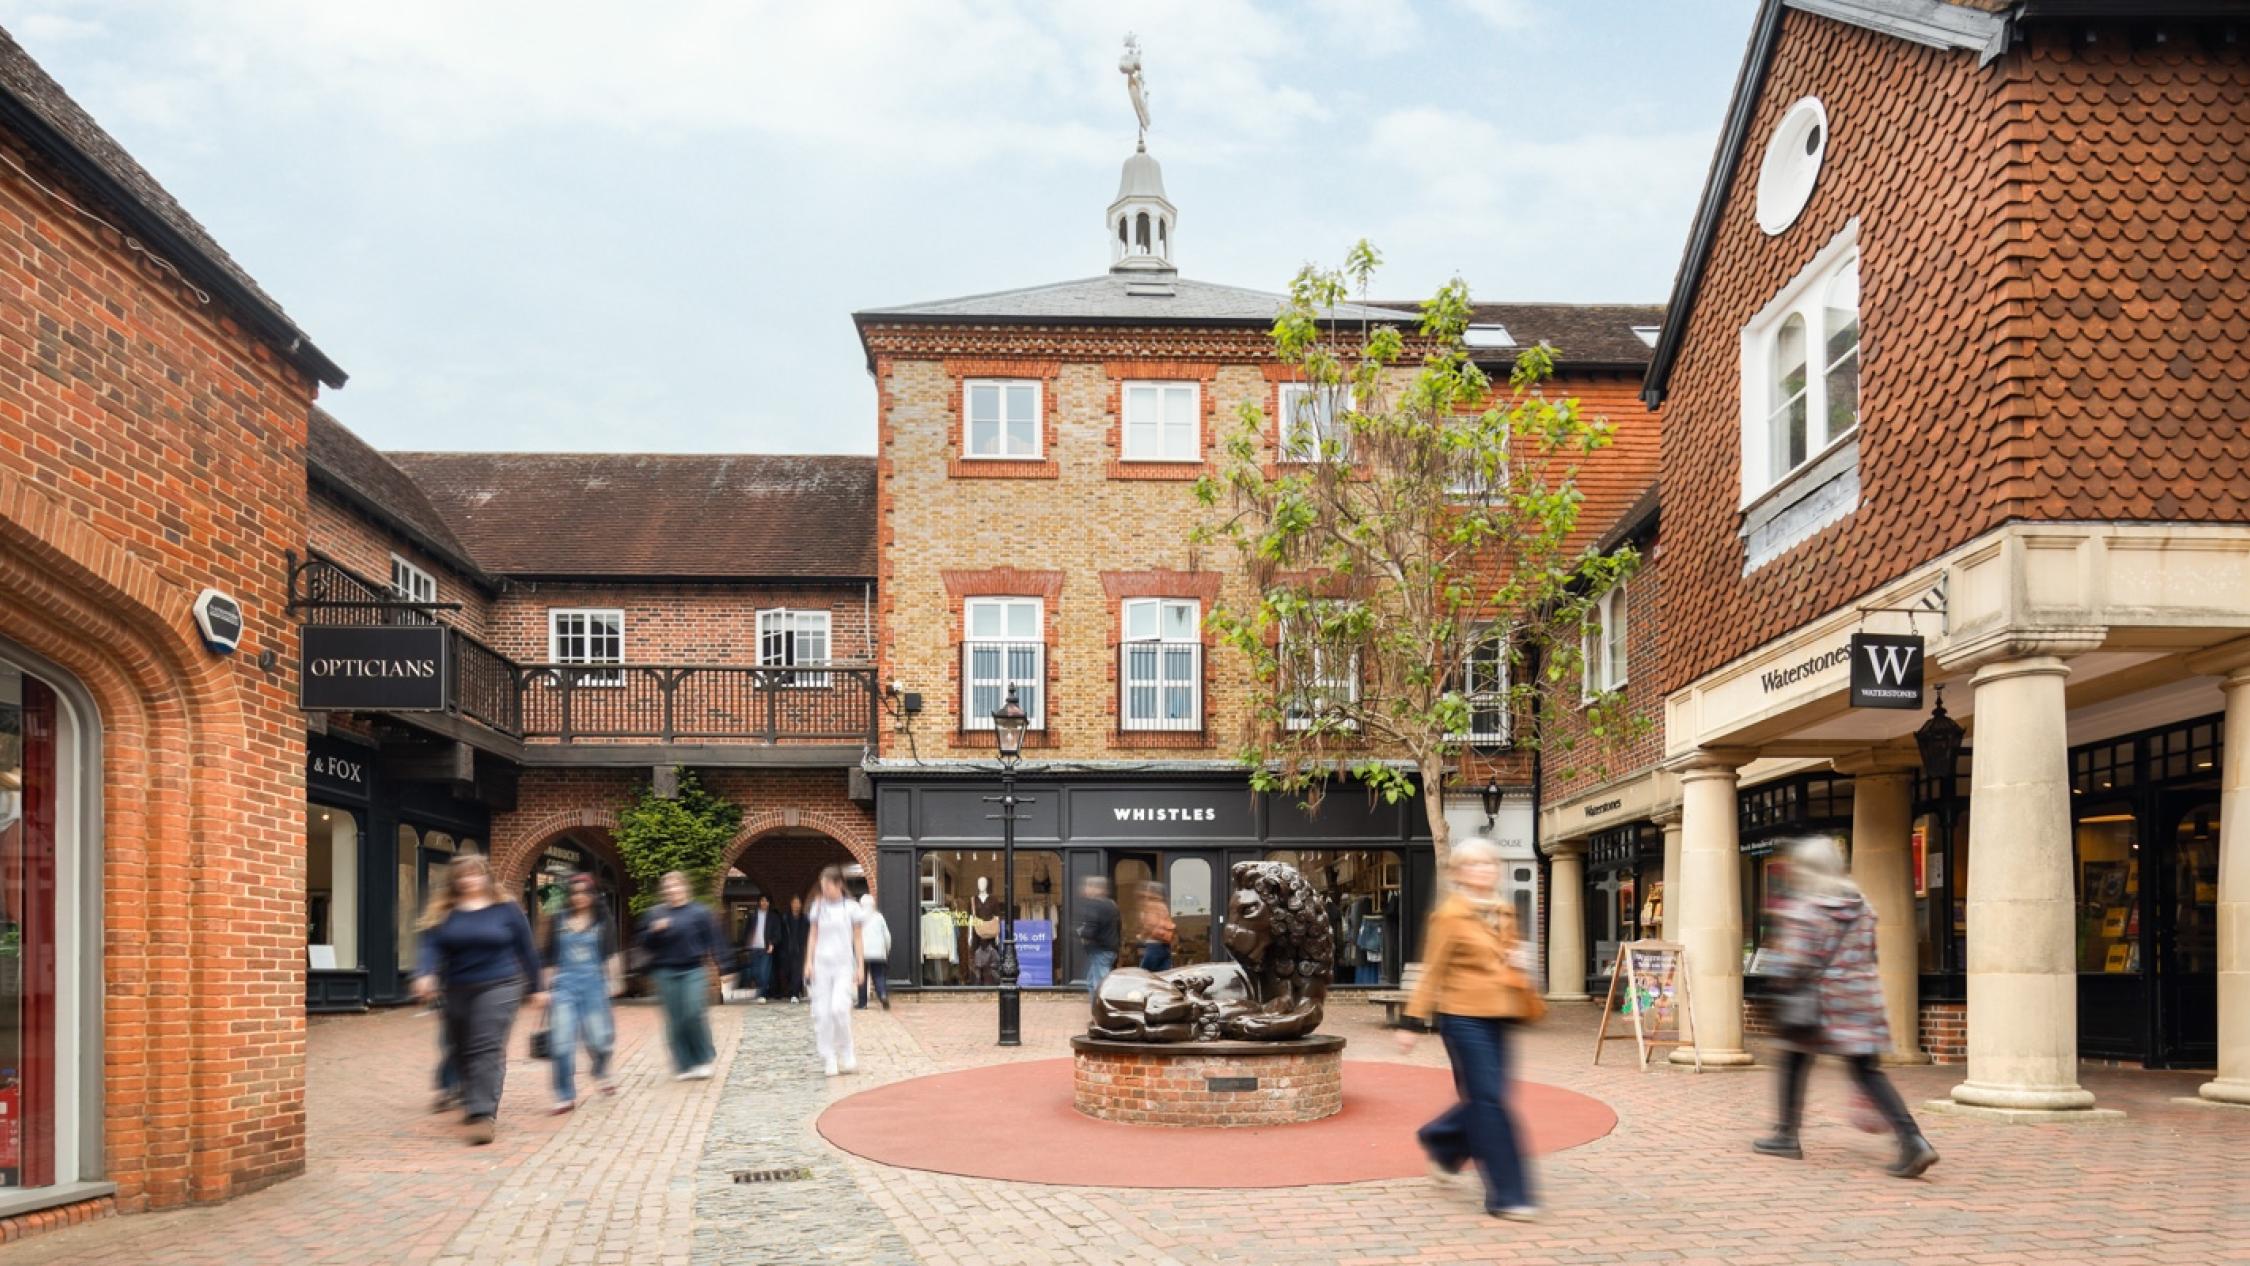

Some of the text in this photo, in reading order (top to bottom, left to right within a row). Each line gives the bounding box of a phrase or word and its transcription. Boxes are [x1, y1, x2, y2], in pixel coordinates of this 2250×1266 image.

[310, 658, 435, 678] OPTICIANS
[1761, 643, 1852, 694] Waterstones
[1863, 645, 1917, 686] W
[1861, 688, 1918, 699] WATERSTONES
[314, 756, 361, 783] & FOX
[1113, 807, 1216, 821] WHISTLES
[1584, 799, 1622, 817] Waterstones
[1013, 932, 1028, 942] 0%
